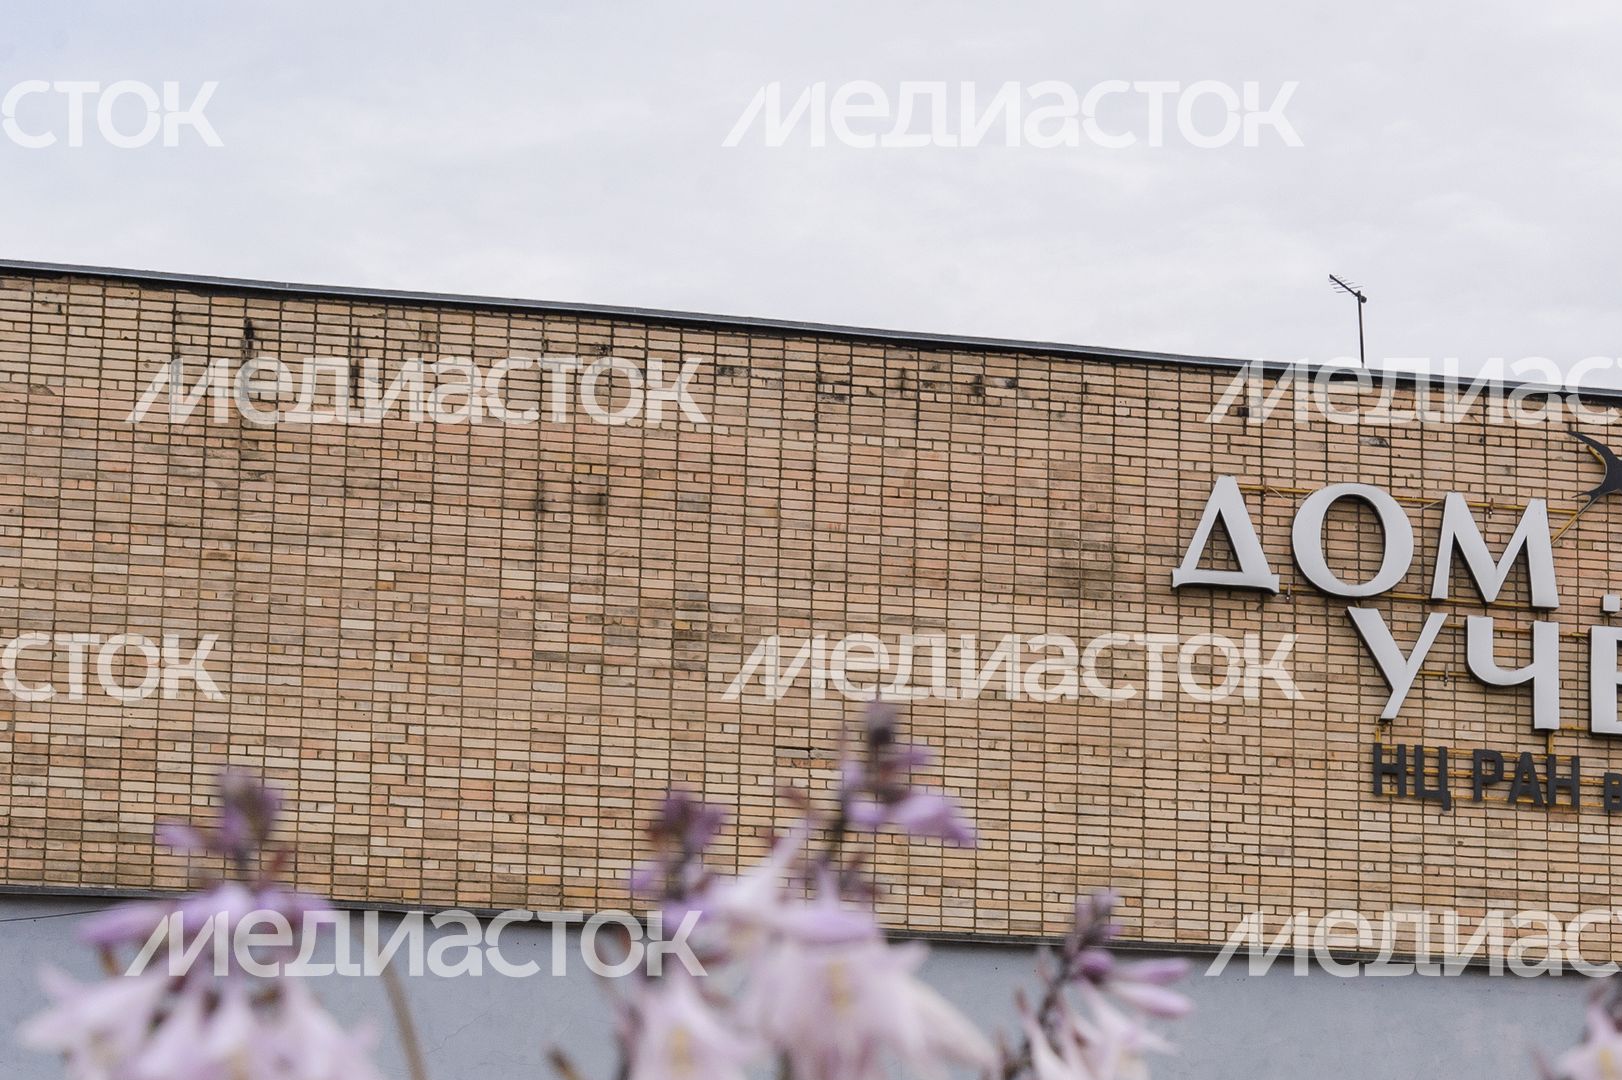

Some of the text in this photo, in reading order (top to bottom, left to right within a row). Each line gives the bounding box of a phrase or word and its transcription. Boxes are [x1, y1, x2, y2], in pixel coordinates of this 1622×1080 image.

[1170, 474, 1560, 610] ДОМ
[1372, 742, 1451, 812] НЦ
[1471, 748, 1581, 809] РАН
